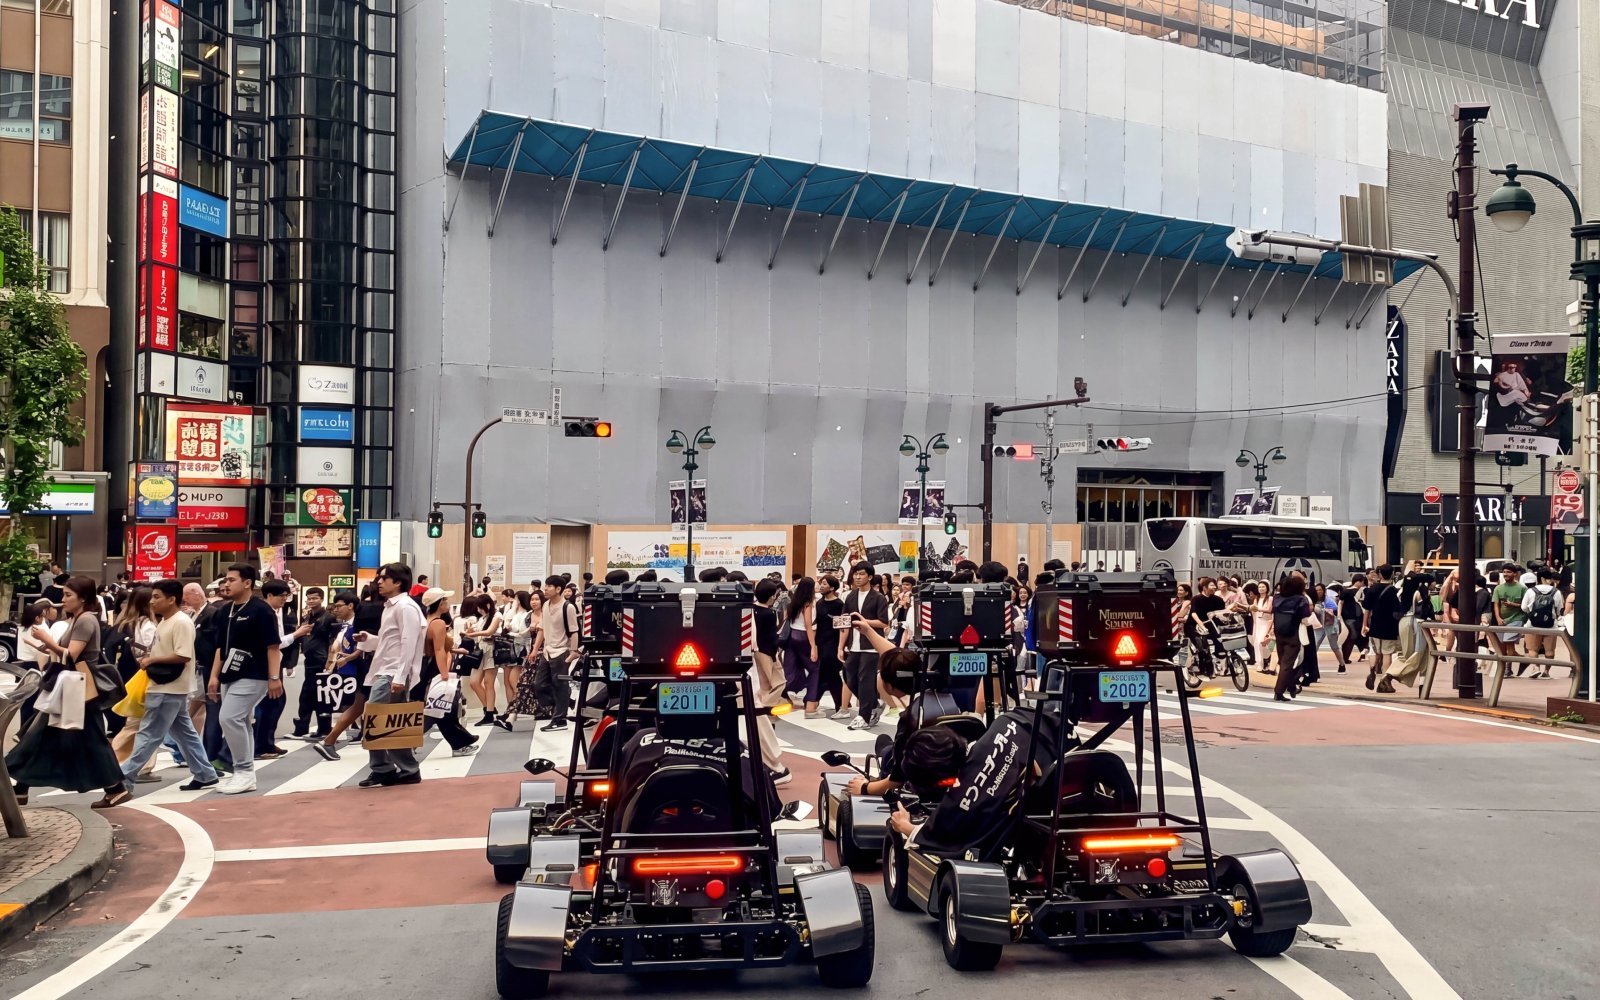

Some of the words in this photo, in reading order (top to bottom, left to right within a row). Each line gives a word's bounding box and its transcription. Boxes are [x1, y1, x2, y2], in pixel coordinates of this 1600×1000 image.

[1386, 319, 1400, 395] ZARA
[191, 493, 223, 501] MUPO
[1456, 496, 1516, 521] AR
[957, 661, 985, 673] 2000
[1109, 683, 1147, 698] 2002
[670, 694, 709, 710] 2011
[385, 712, 423, 728] NIKE
